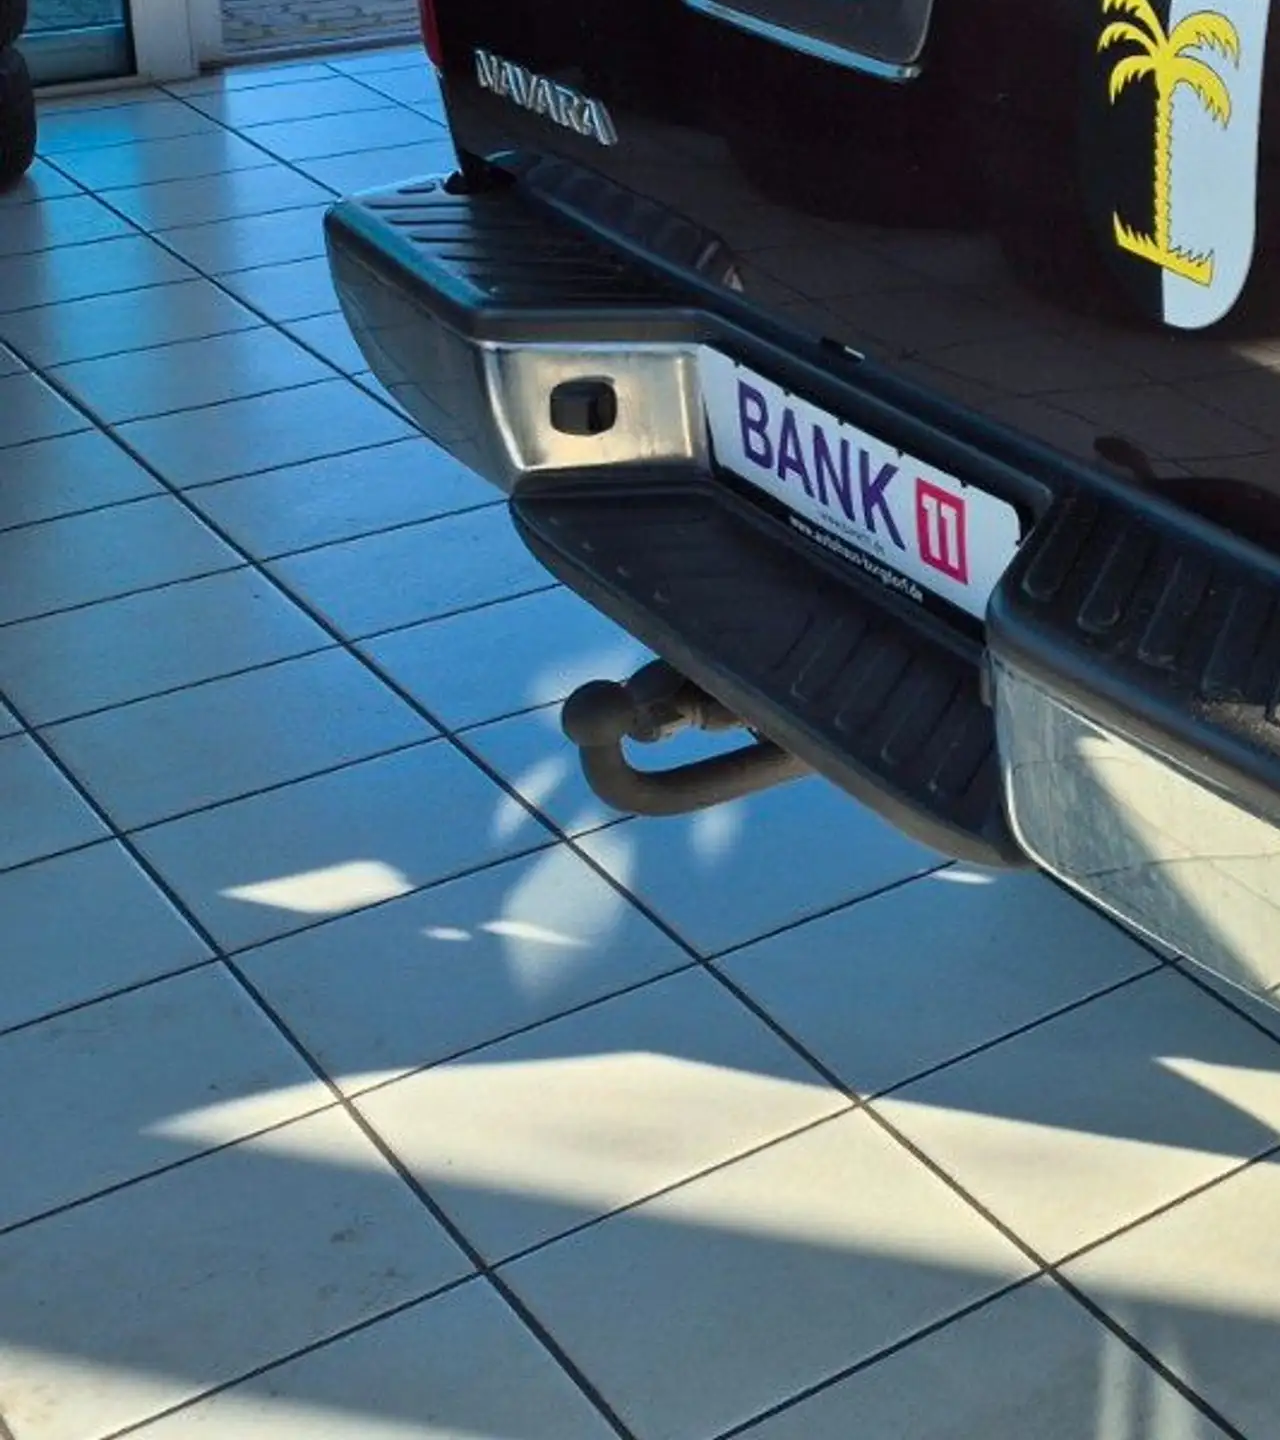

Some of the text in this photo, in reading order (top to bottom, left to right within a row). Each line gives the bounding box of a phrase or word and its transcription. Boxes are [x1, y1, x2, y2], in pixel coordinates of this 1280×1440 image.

[475, 49, 618, 145] NAVARA
[738, 378, 964, 575] BANK 11
